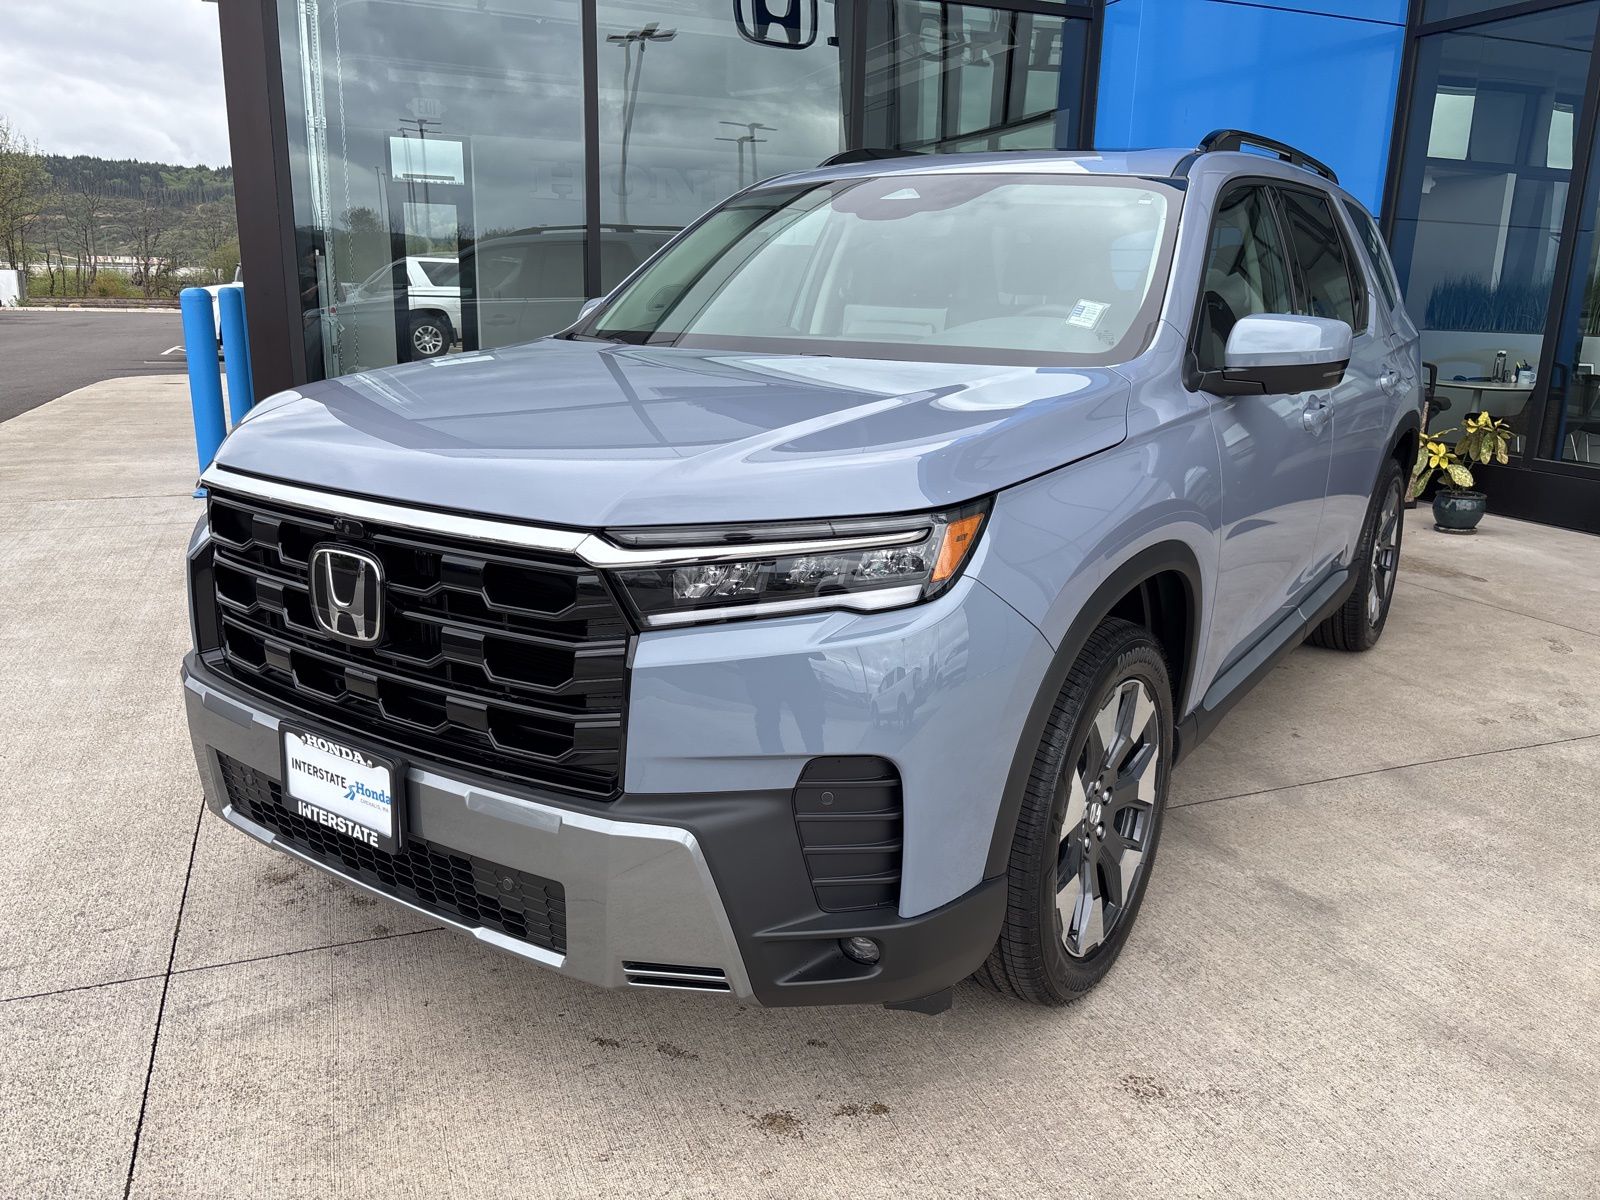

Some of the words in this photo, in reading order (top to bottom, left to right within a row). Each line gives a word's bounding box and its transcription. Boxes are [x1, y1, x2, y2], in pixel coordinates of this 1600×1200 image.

[1116, 646, 1165, 684] BRIDGES
[304, 733, 367, 766] HONDA
[291, 757, 347, 789] INTERSTATE
[355, 781, 391, 805] Honda
[298, 801, 379, 848] INTERSTATE
